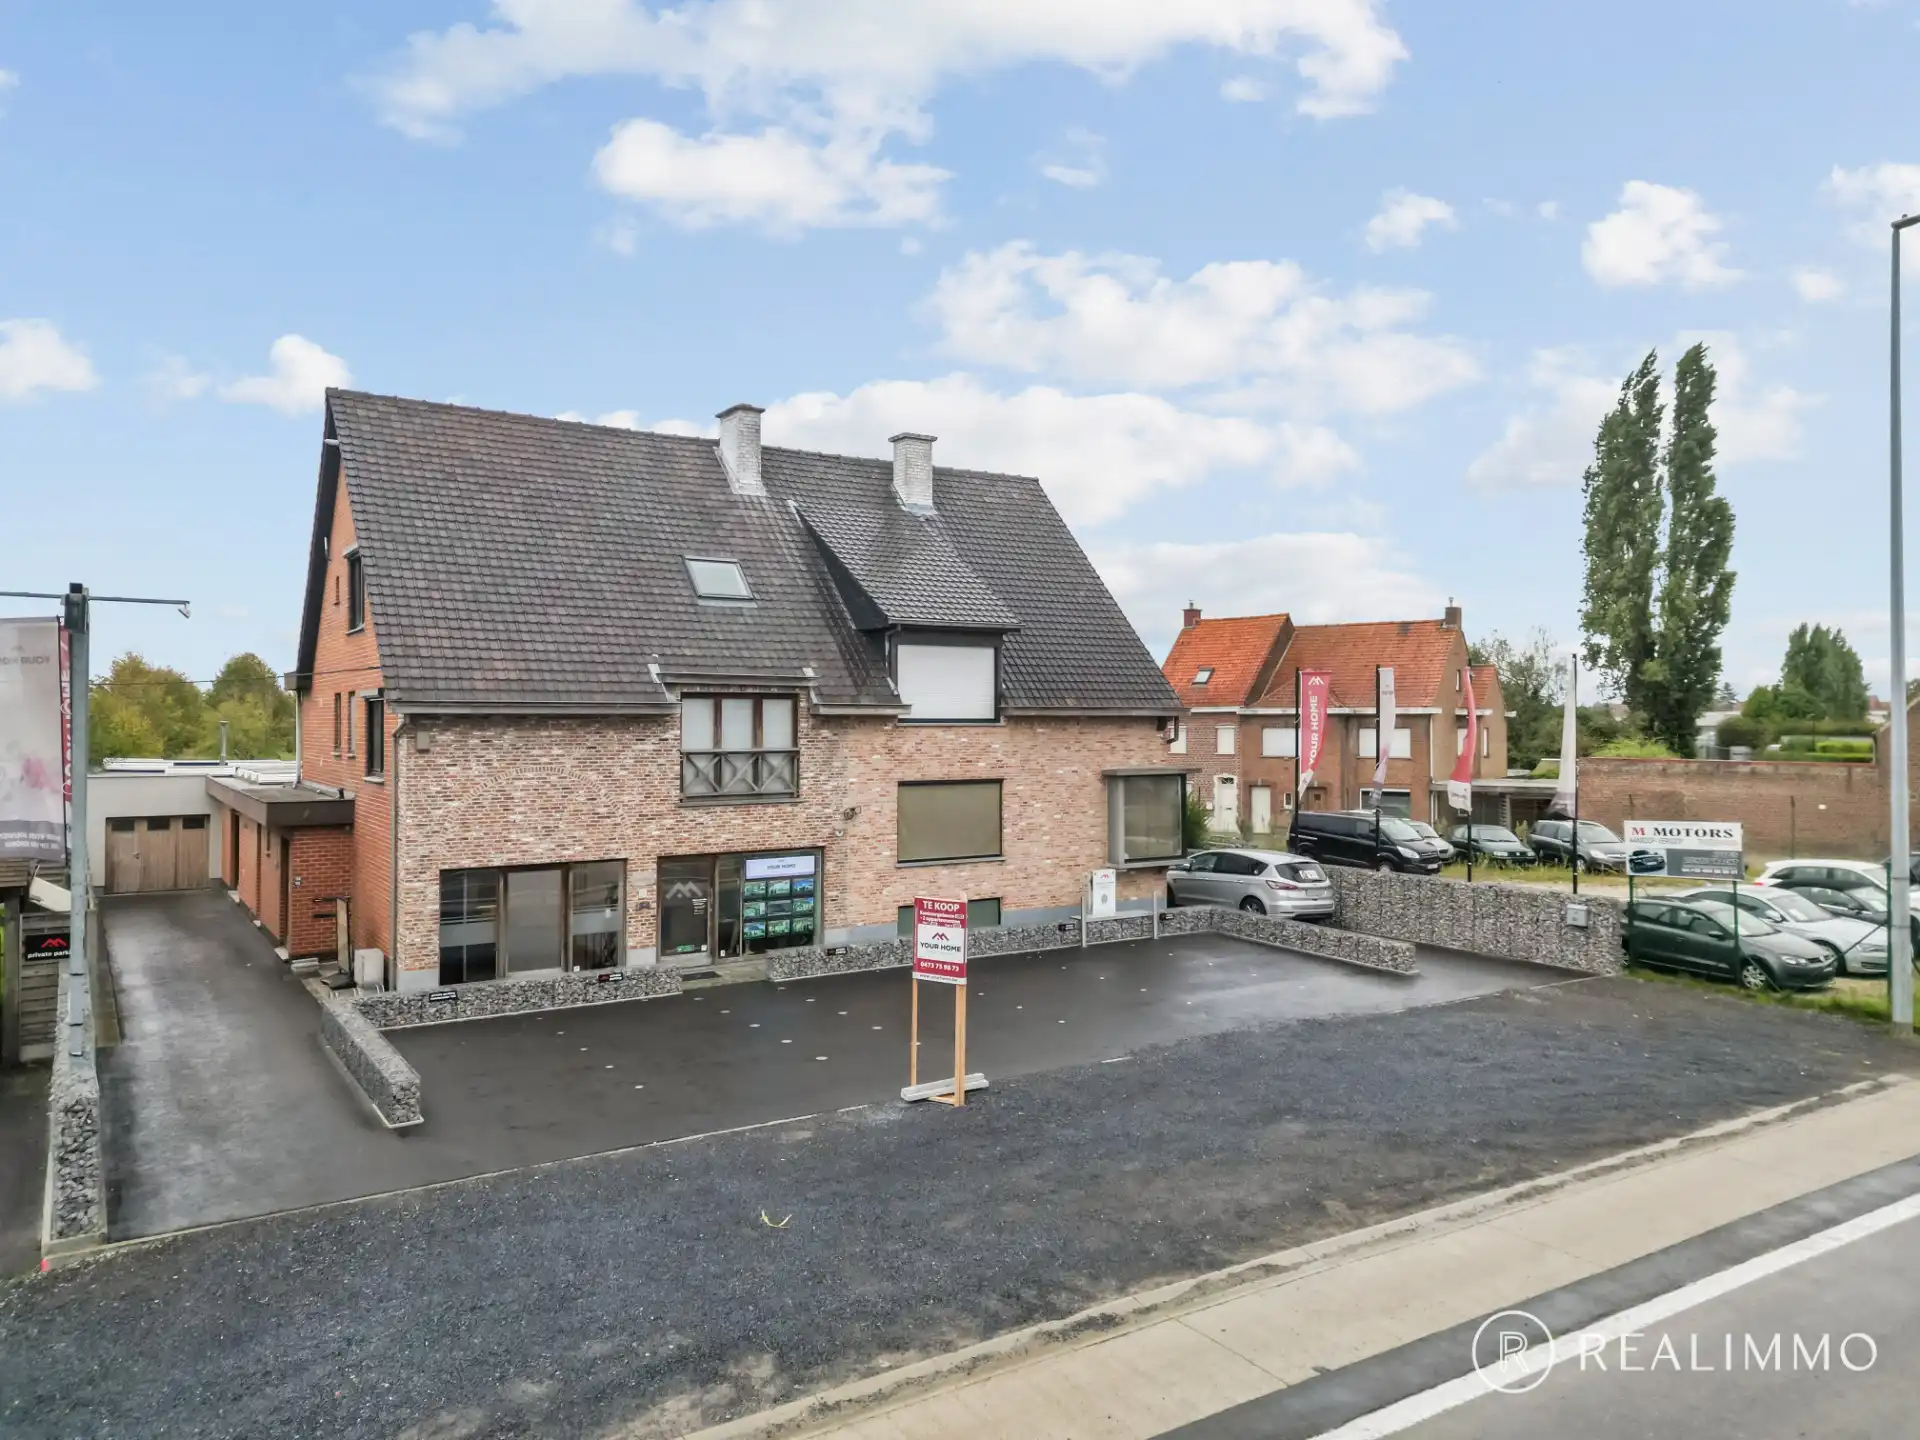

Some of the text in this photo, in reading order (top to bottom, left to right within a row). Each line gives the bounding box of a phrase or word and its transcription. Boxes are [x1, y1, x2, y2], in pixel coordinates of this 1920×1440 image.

[1308, 695, 1319, 766] YOUR HOME
[1632, 827, 1734, 838] M MOTORS
[922, 900, 960, 912] TE KOOP
[920, 942, 962, 953] YOUR HOME
[27, 951, 53, 959] private
[920, 961, 935, 969] 0473
